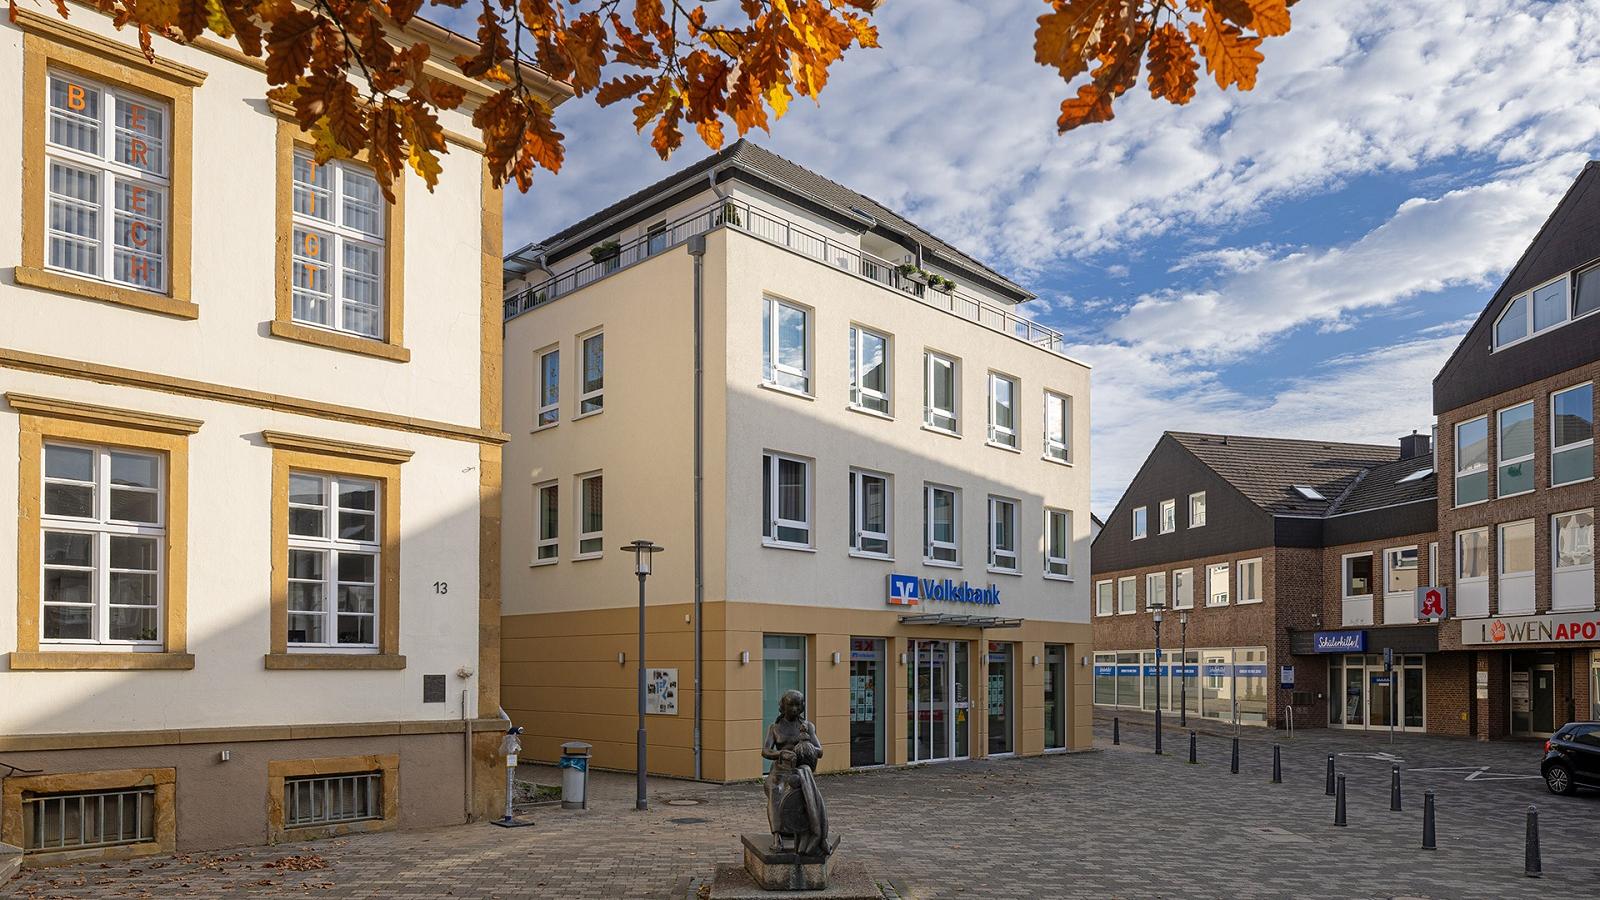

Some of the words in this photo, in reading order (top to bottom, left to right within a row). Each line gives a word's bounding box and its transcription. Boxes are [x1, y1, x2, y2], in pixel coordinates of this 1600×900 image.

[433, 581, 448, 595] 13
[922, 578, 1001, 605] Volksbank
[1555, 620, 1600, 640] APO
